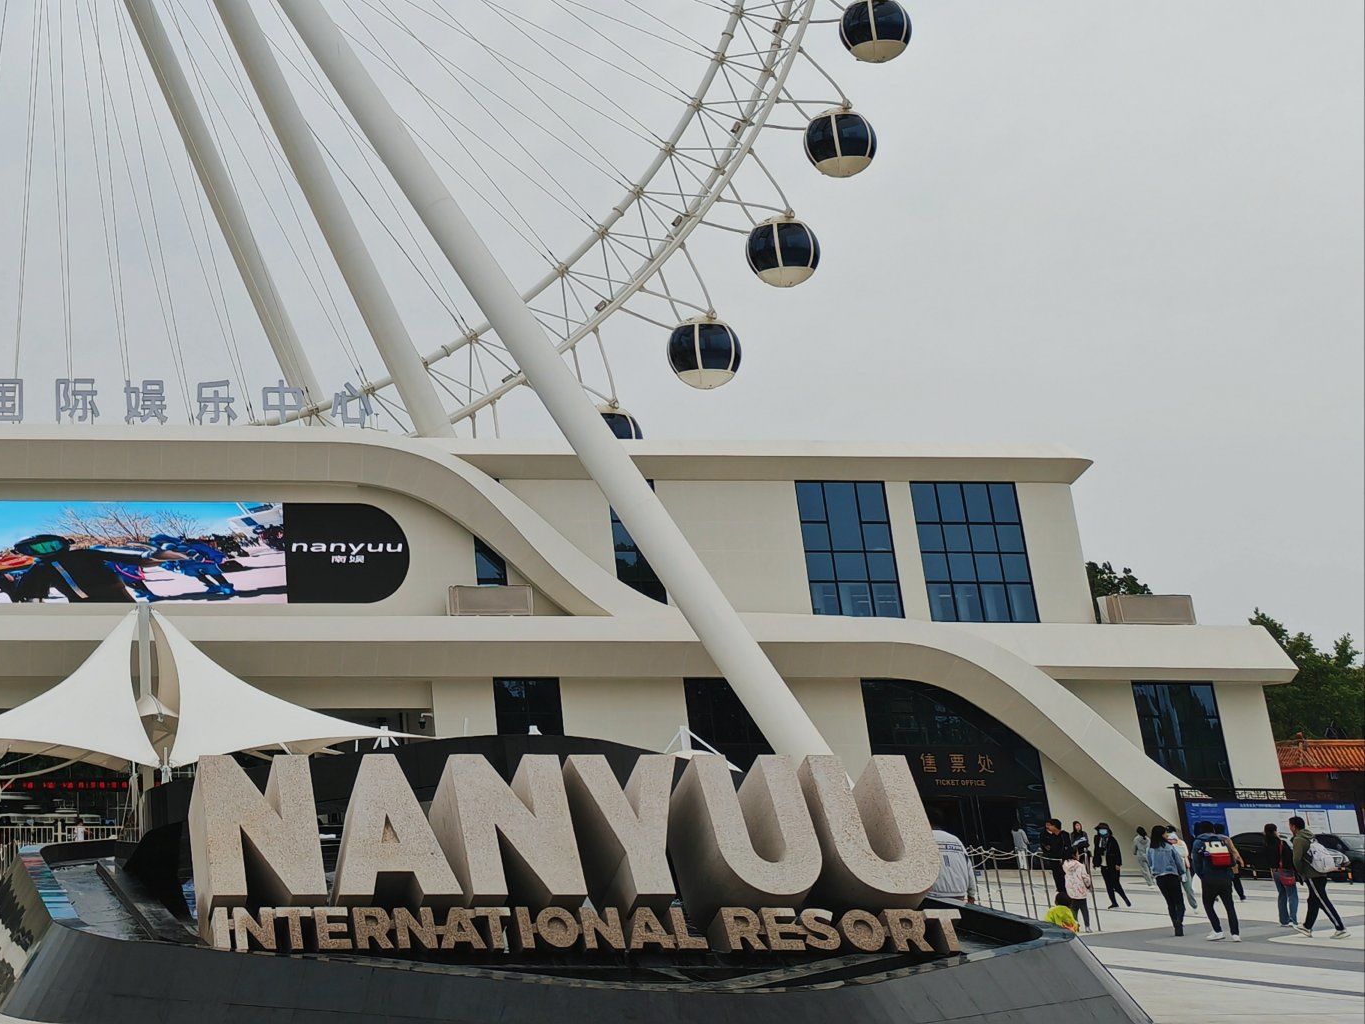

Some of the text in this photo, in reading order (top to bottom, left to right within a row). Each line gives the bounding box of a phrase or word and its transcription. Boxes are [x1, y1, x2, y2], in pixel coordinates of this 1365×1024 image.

[291, 542, 402, 555] nanyuu
[920, 753, 995, 773] 售票处
[935, 778, 986, 787] TICKET OFFICE
[188, 754, 941, 906] NANYUU
[210, 905, 962, 954] INTERNATIONAL RESORT
